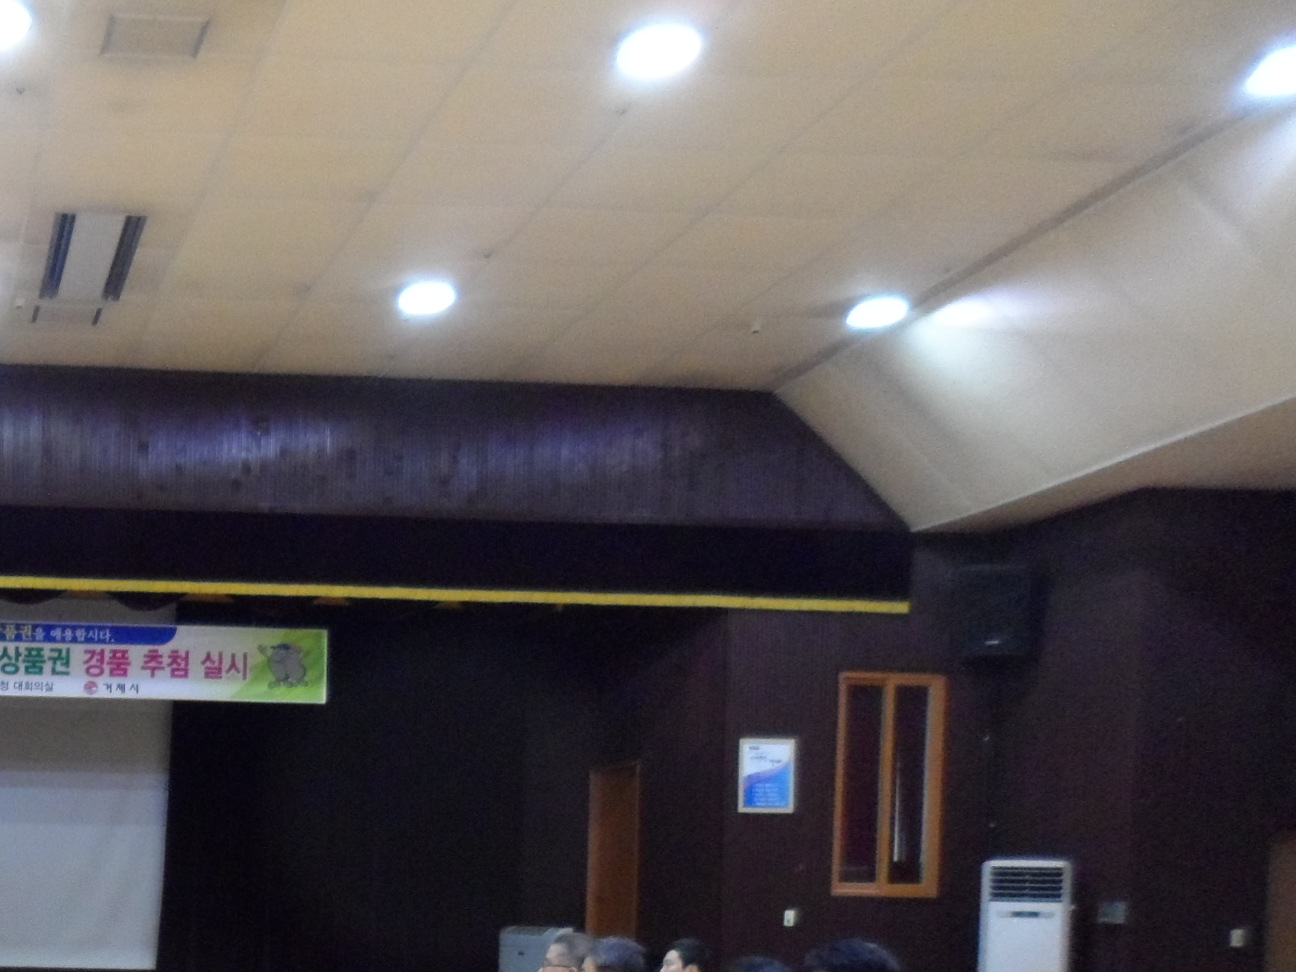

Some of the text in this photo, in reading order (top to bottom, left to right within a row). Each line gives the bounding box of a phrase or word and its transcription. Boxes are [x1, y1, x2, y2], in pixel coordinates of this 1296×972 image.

[82, 647, 132, 679] 경품
[140, 648, 191, 680] 추첨
[200, 650, 249, 682] 실시
[13, 680, 54, 693] 대회의실
